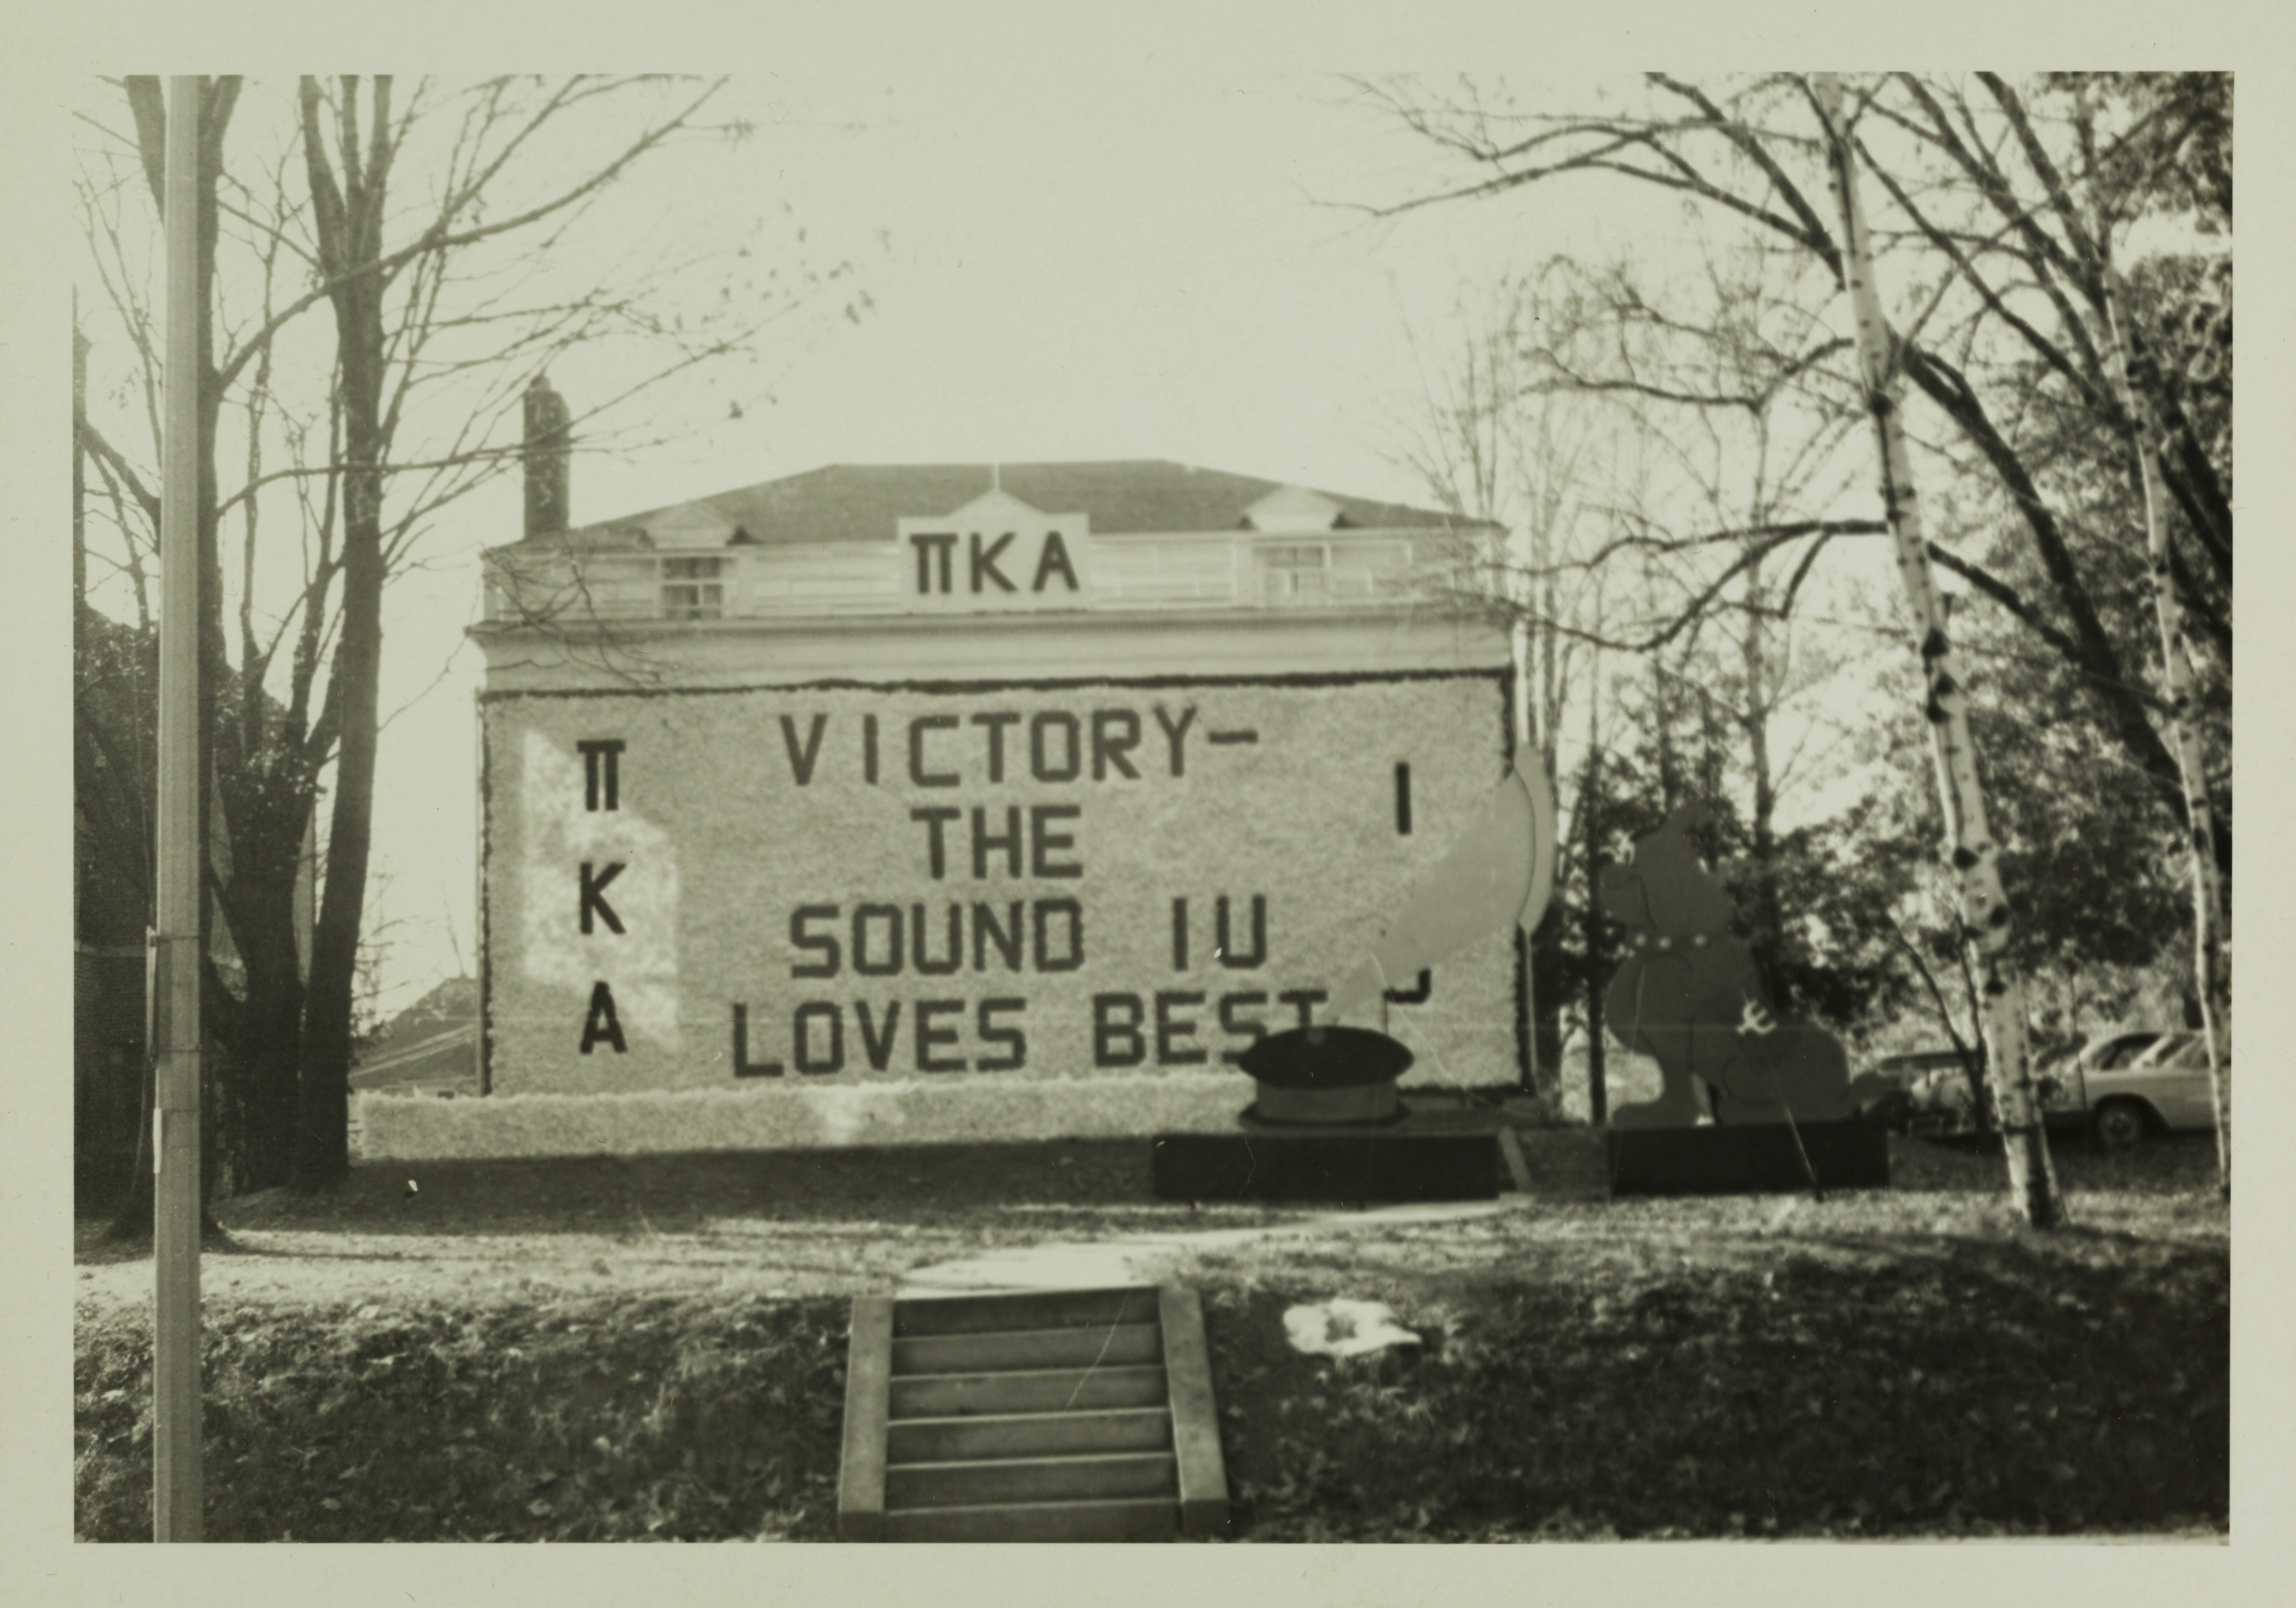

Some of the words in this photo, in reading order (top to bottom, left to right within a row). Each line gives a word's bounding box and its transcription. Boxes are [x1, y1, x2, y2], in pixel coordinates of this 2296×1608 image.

[909, 804, 1084, 881] THE
[789, 895, 1085, 980] SOUND
[1171, 893, 1268, 972] IU
[731, 996, 1027, 1079] LOVES
[1092, 988, 1328, 1068] BEST
